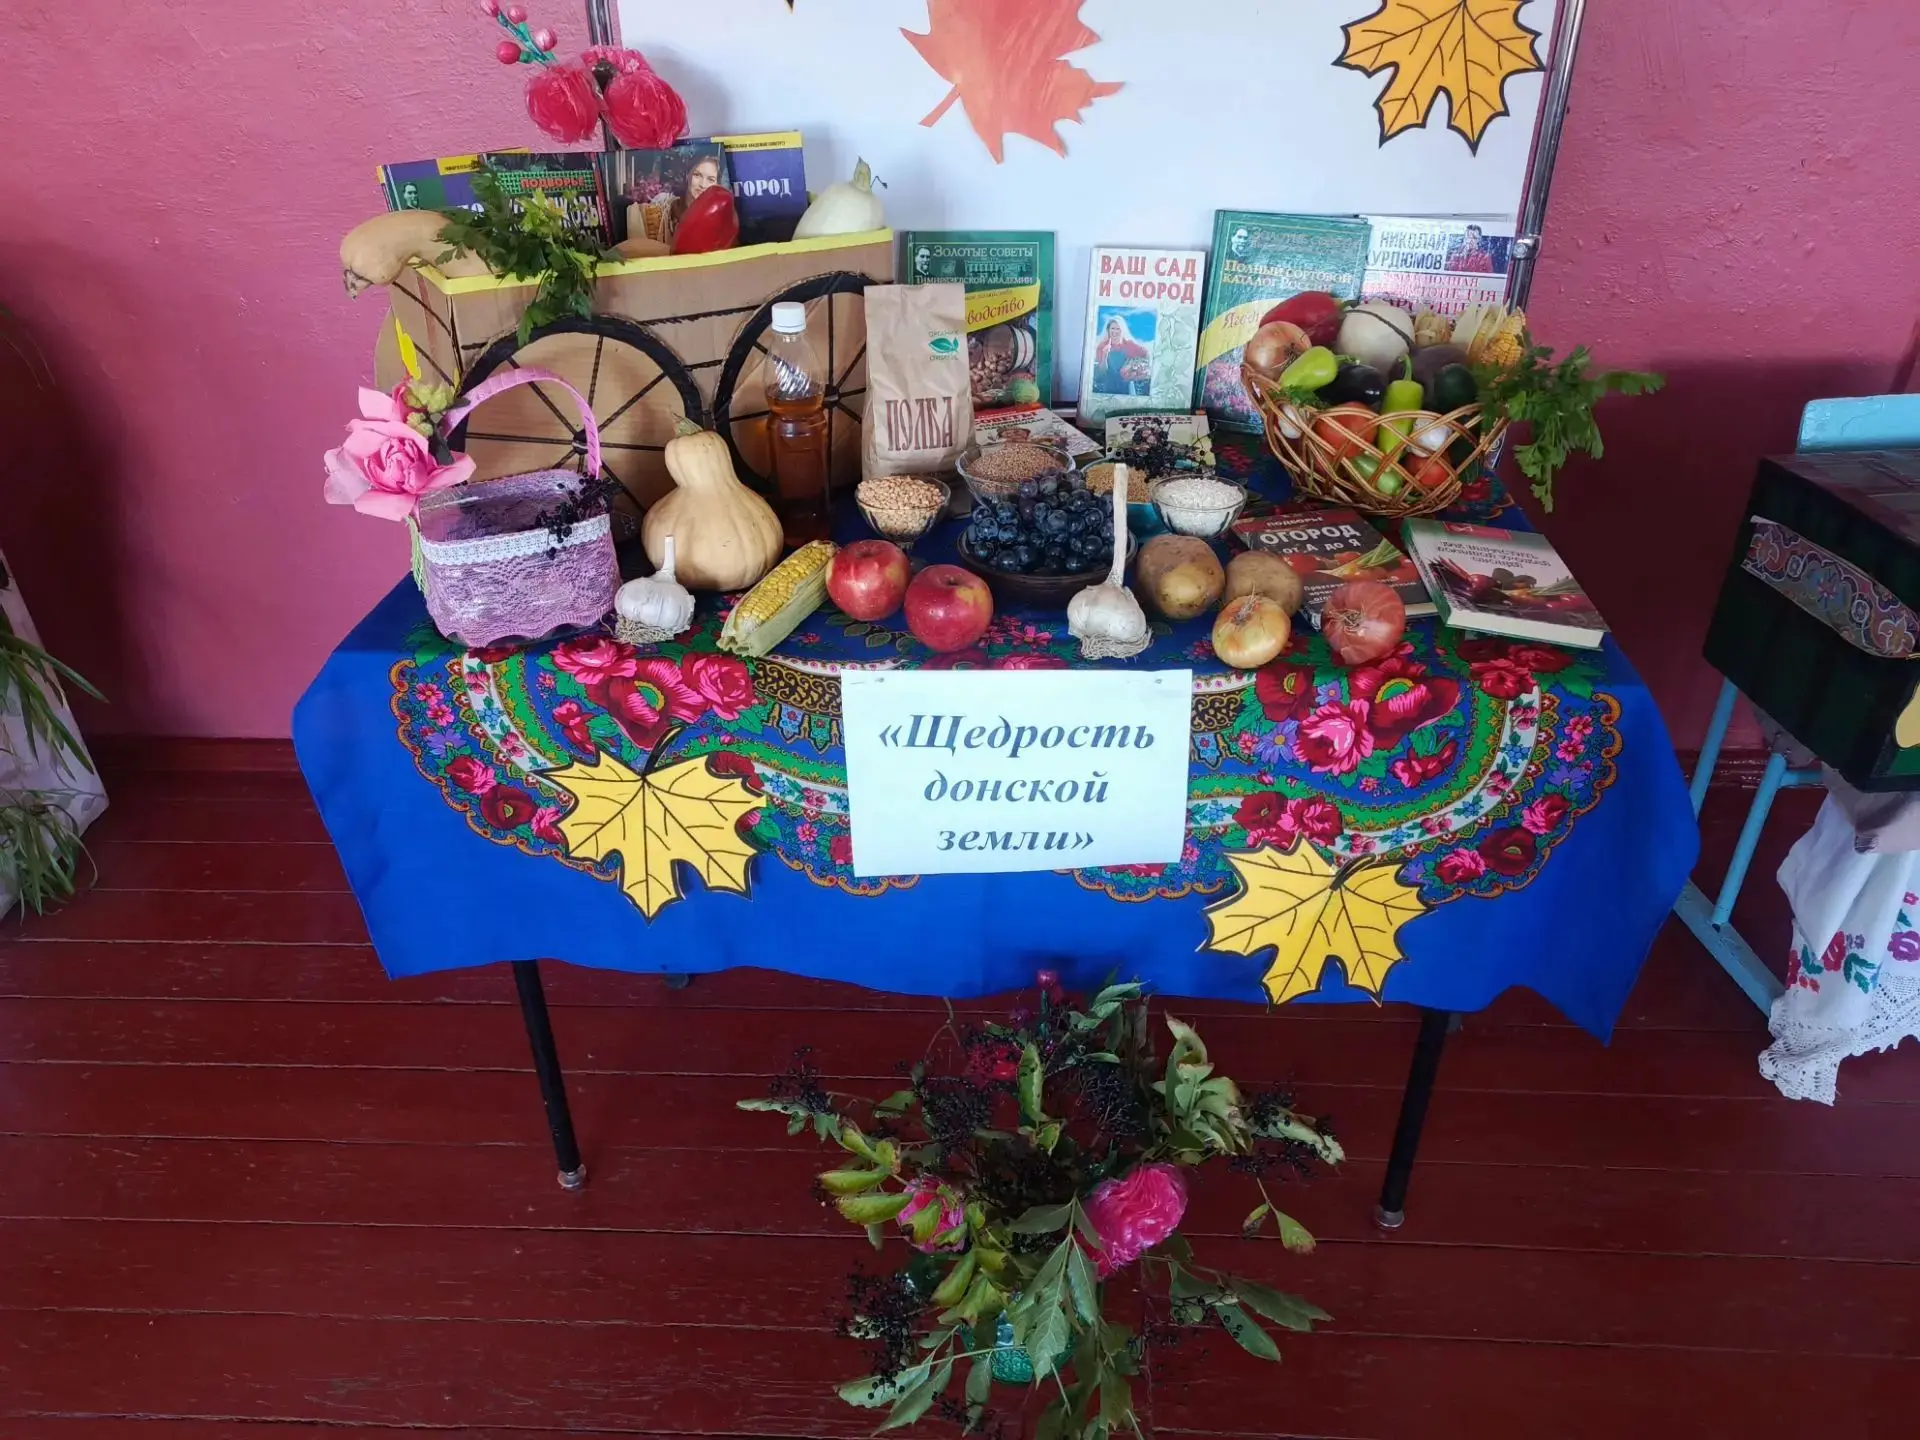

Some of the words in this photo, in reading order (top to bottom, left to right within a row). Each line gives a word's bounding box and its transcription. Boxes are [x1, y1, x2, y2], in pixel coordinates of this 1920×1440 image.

[1380, 230, 1446, 251] НИКОЛАЙ
[1100, 255, 1147, 275] ВАШ
[1154, 257, 1197, 281] САД
[1099, 279, 1111, 297] И
[1119, 280, 1195, 304] ОГОРОД
[885, 396, 953, 451] ПОЛБА
[1259, 524, 1362, 545] ОГОРОД
[1348, 538, 1362, 548] Я
[878, 714, 1155, 758] «Щедрость
[923, 769, 1110, 804] донской
[936, 829, 1095, 851] земли»
